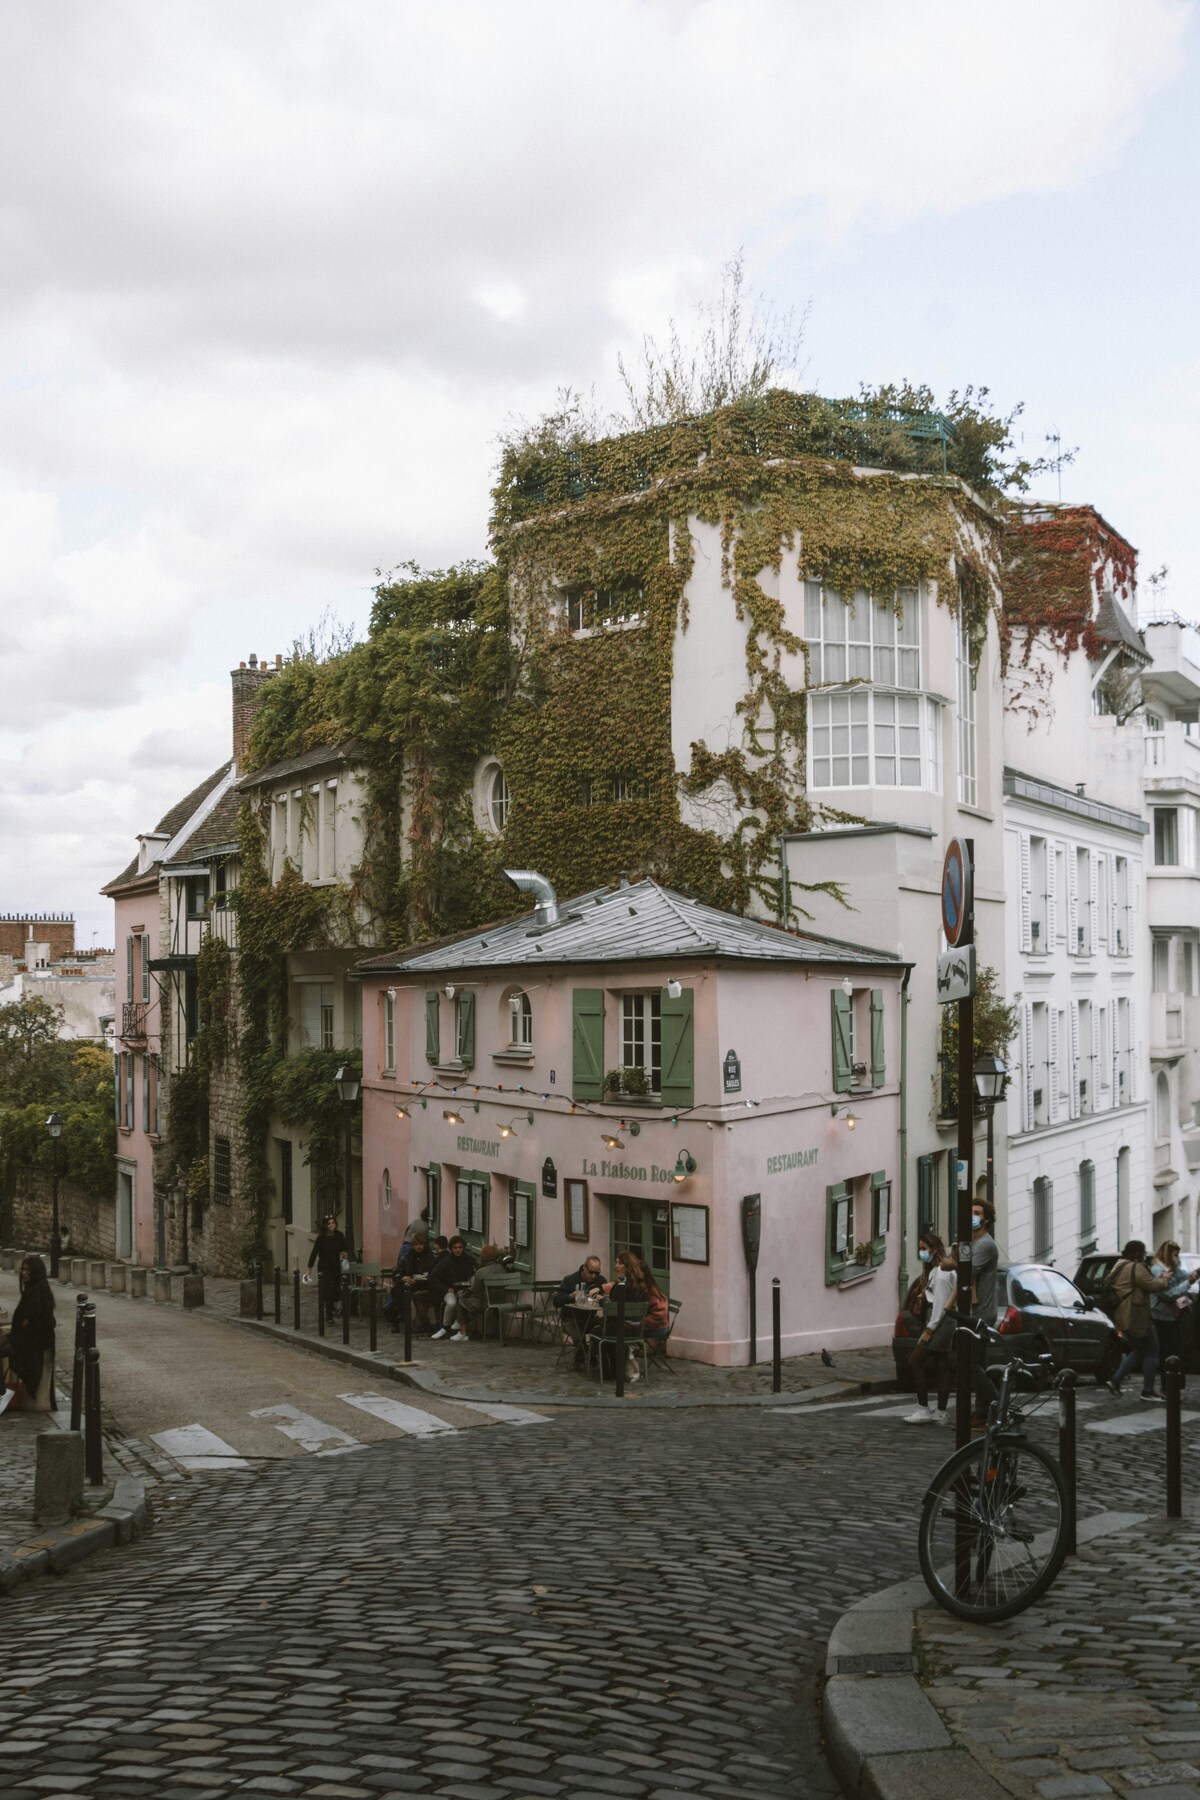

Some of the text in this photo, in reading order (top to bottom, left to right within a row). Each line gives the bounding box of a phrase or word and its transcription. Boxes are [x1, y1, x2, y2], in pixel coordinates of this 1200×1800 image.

[457, 1135, 500, 1158] RESTAURANT
[582, 1159, 681, 1184] La Maison Ros
[767, 1147, 818, 1175] RESTAURANT
